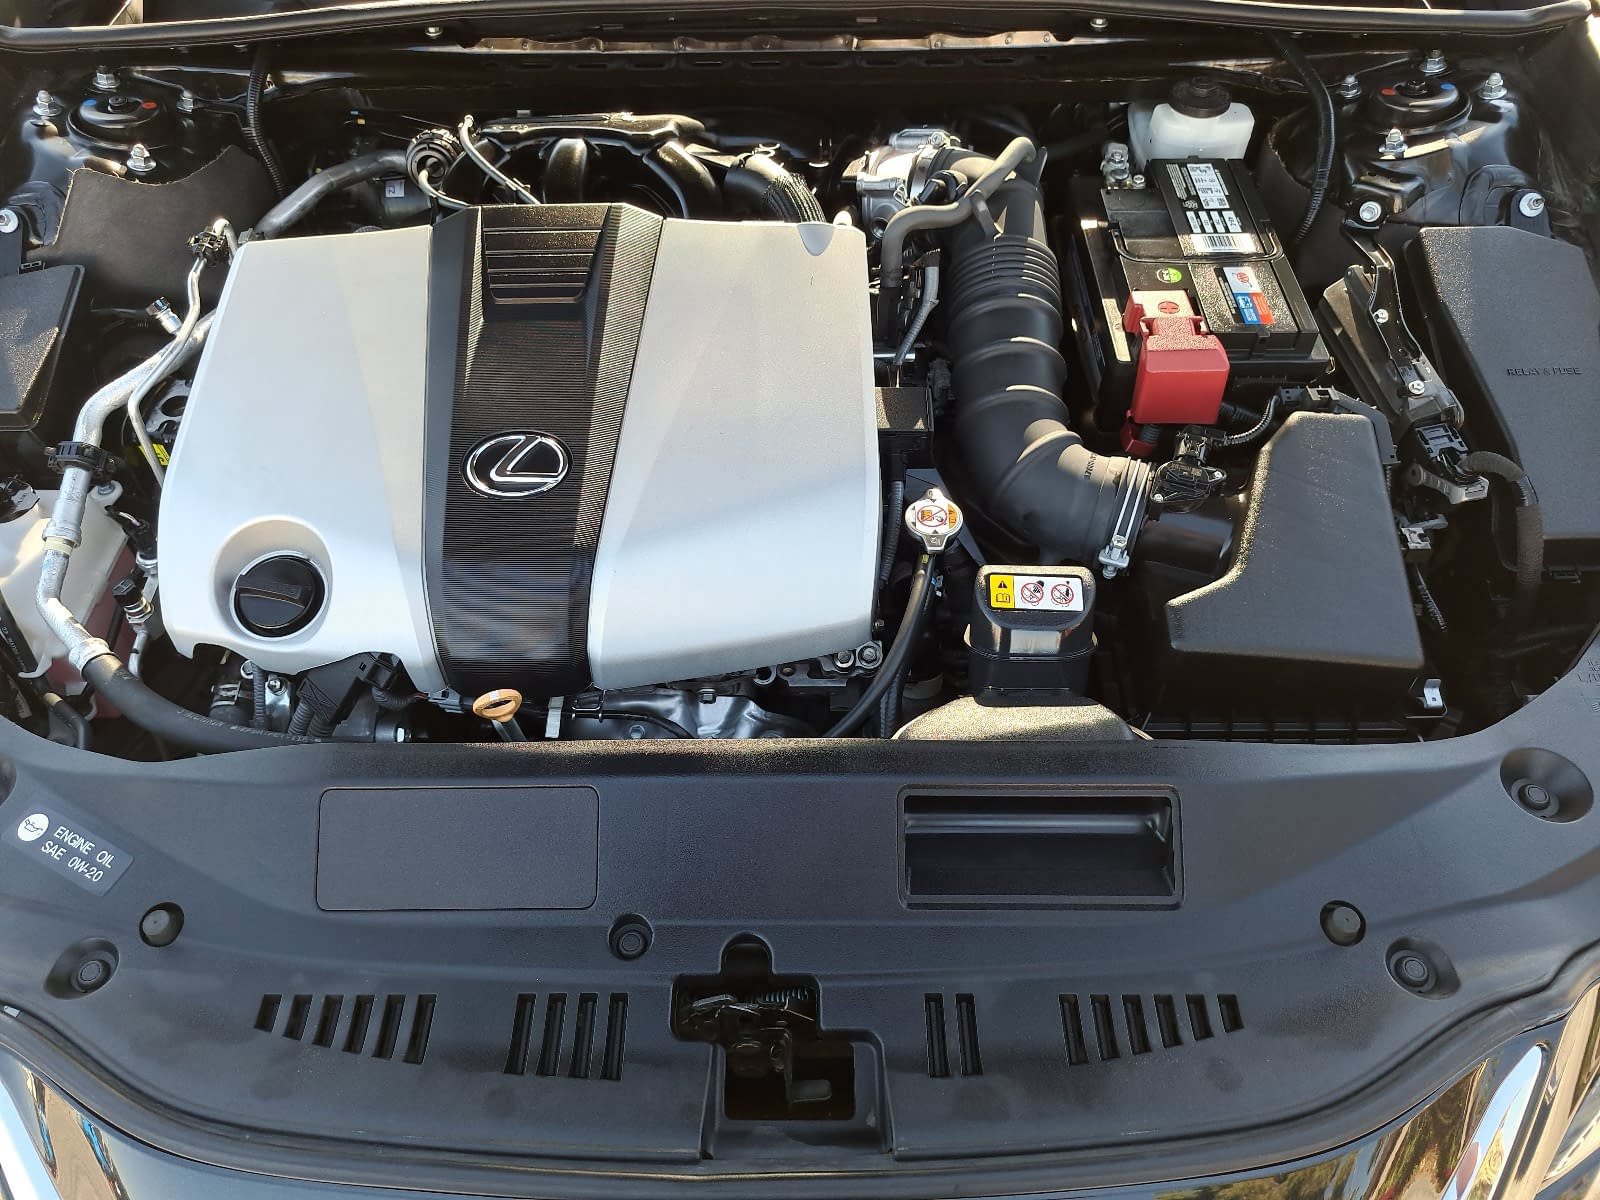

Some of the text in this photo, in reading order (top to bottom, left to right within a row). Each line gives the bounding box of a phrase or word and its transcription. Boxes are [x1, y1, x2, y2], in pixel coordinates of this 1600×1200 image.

[1553, 367, 1583, 375] FUSE
[41, 840, 104, 882] SAE 0W-20
[53, 825, 115, 868] ENGINE OIL
